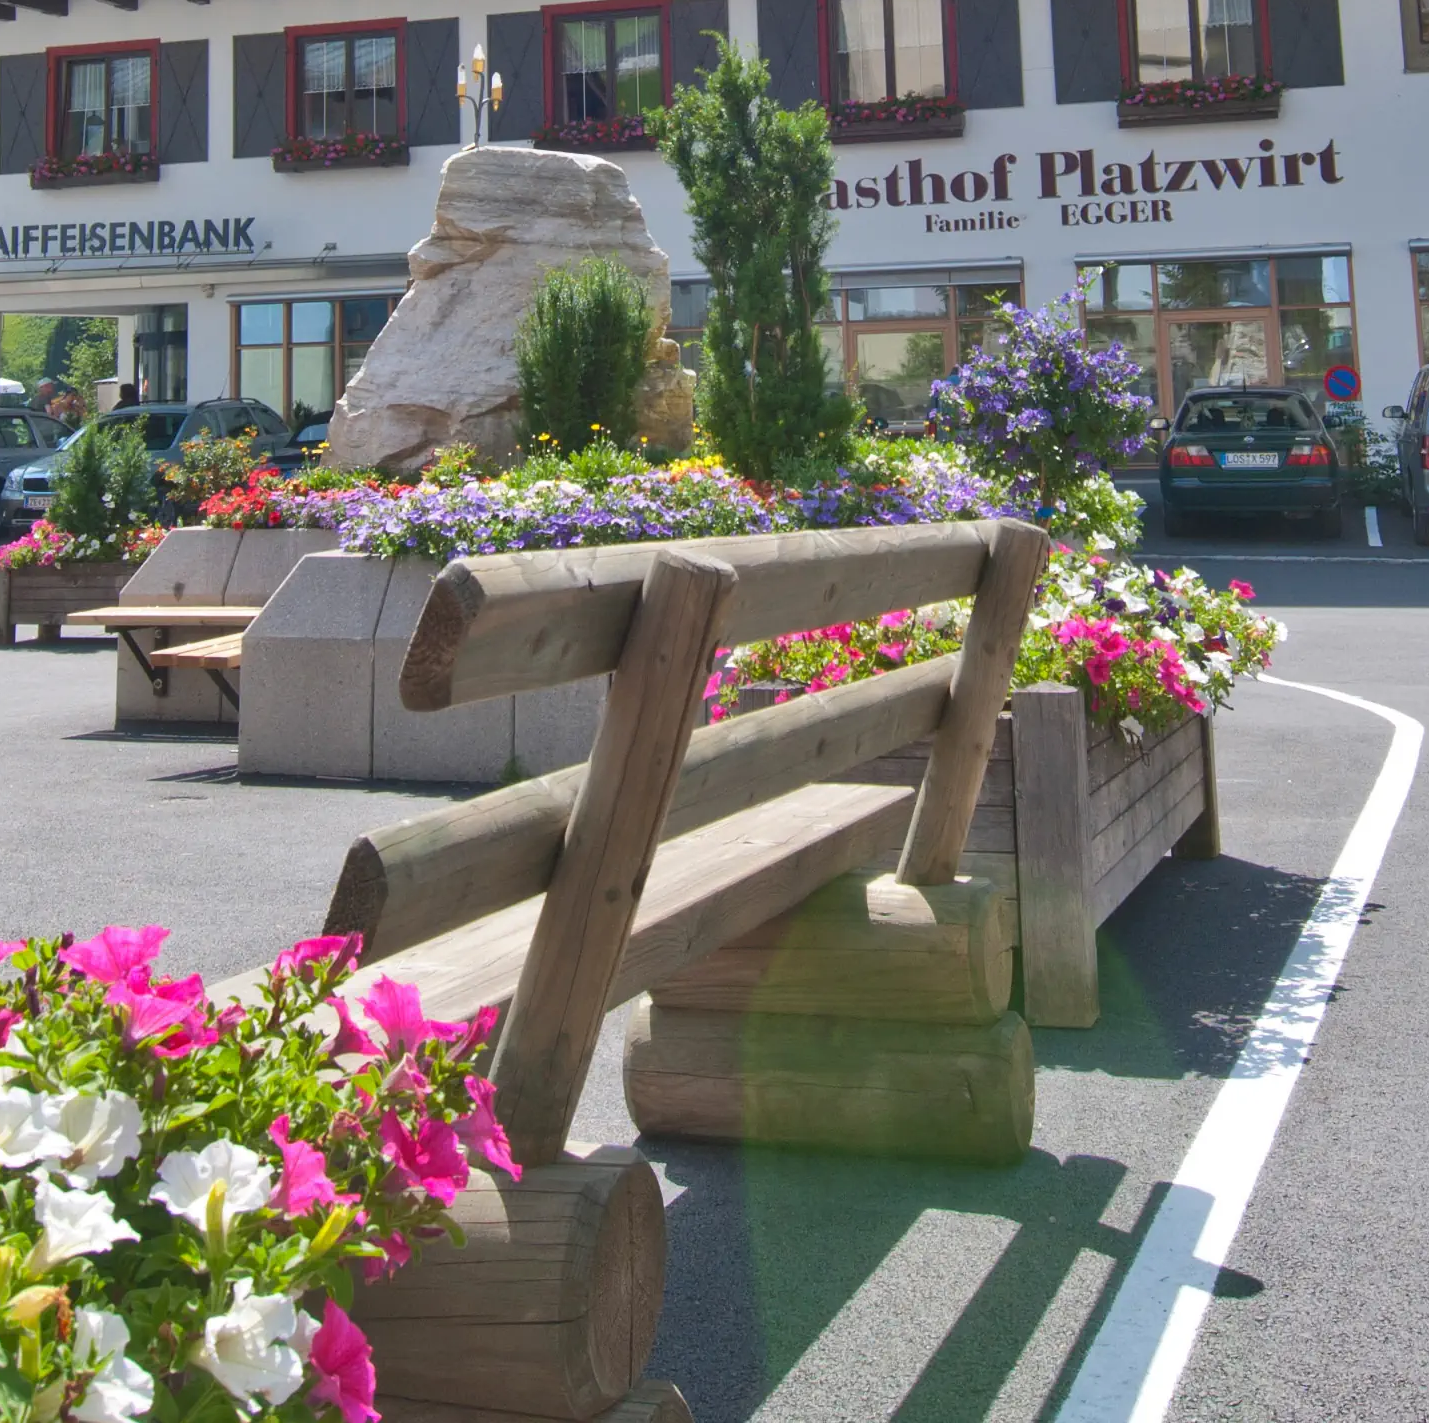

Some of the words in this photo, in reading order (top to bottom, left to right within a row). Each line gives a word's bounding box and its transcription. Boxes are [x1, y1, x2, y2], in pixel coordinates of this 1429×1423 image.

[818, 153, 1017, 211] asthof
[1035, 138, 1345, 199] Platzwirt
[925, 210, 1021, 234] Familie
[1060, 199, 1174, 227] EGGER
